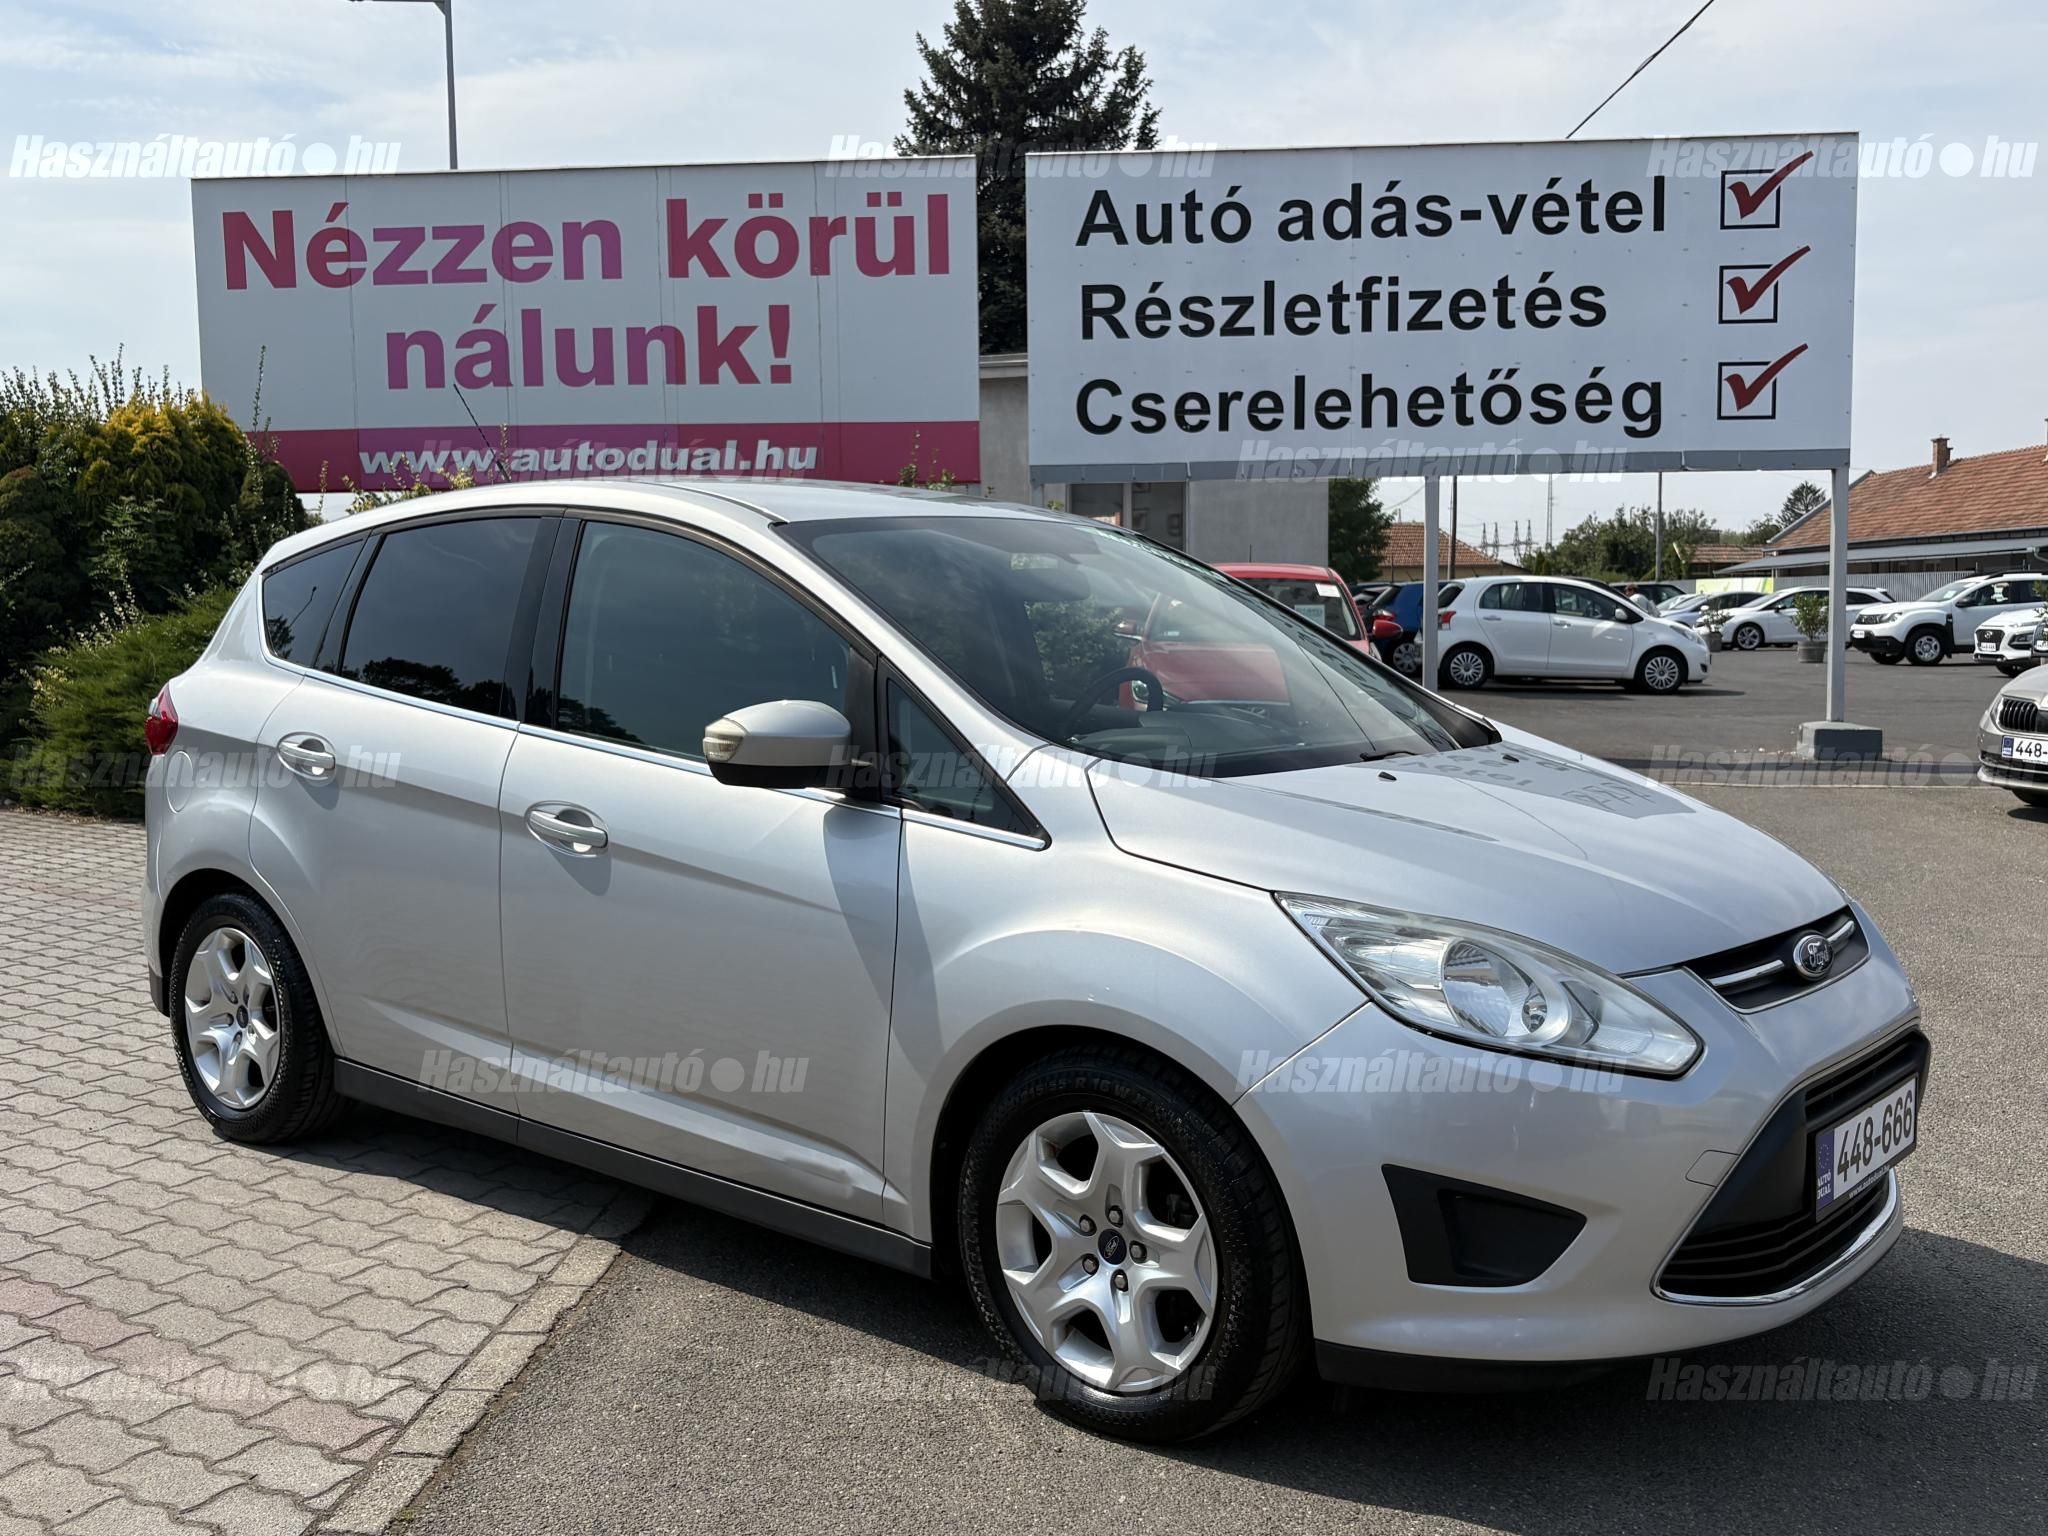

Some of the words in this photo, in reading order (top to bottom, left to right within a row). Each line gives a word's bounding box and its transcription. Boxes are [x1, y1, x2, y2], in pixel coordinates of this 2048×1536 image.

[222, 202, 623, 290] Nézzen
[666, 191, 950, 279] körül
[1075, 185, 1251, 247] Autó
[1277, 175, 1667, 242] adás-vétel
[1080, 270, 1608, 340] Részletfizetés
[386, 303, 792, 390] nálunk!
[1075, 366, 1664, 439] Cserelehetőség
[1837, 1089, 1913, 1183] 448-666
